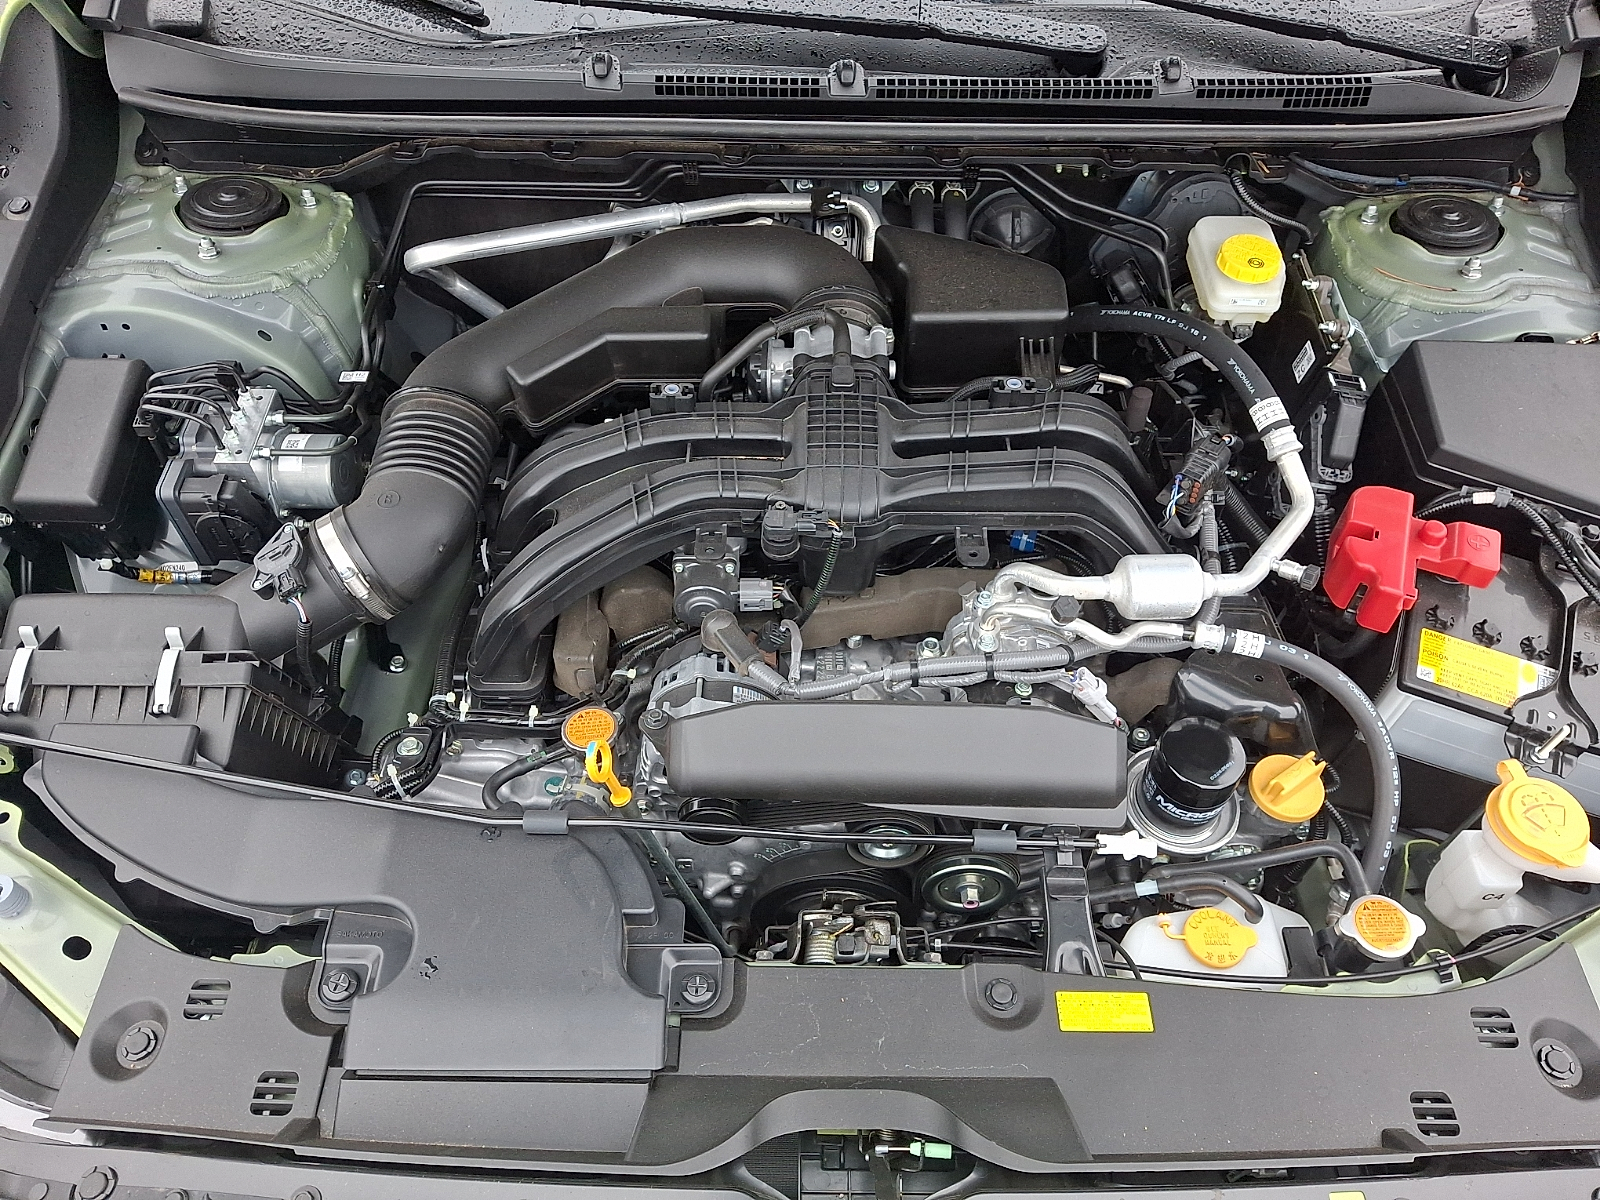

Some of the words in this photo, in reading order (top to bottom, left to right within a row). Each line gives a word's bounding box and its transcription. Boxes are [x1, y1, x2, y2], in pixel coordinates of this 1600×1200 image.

[1232, 363, 1256, 395] YOKOHAMA
[1424, 630, 1452, 642] DANGER
[1279, 644, 1297, 655] 03
[1422, 648, 1449, 661] POISON
[1347, 681, 1377, 718] YOKOHAMA
[1393, 790, 1400, 807] HP
[1481, 892, 1506, 901] C4
[1188, 910, 1239, 930] COOLANT
